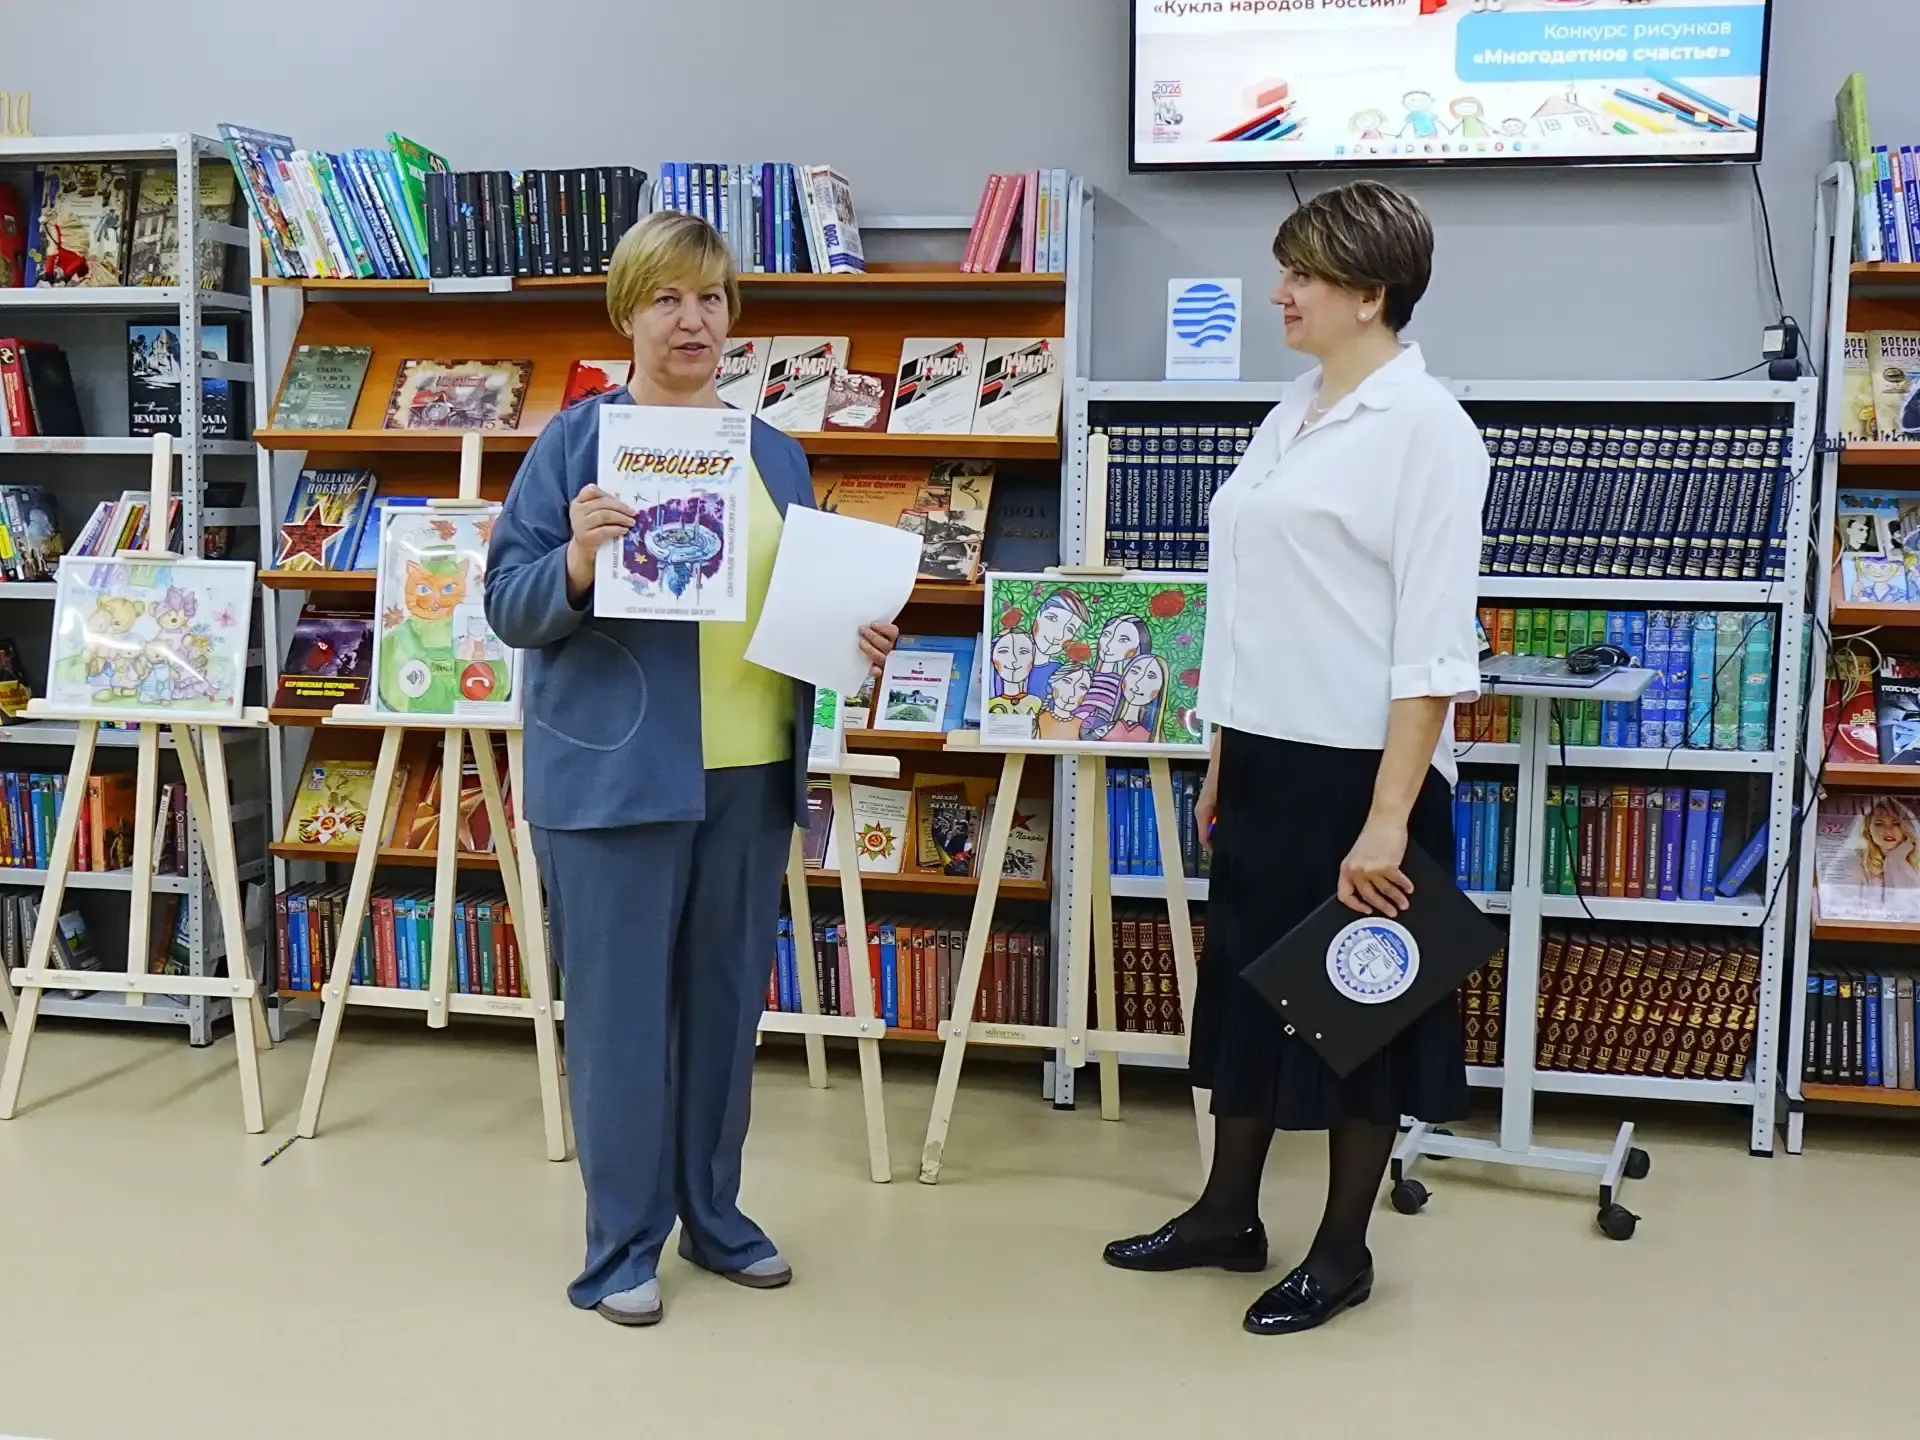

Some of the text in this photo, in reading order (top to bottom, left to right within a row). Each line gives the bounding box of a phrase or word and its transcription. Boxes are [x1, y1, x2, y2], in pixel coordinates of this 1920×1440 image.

[1230, 0, 1315, 16] народов
[1543, 21, 1733, 41] Конкурс рисунков
[1473, 44, 1731, 65] «Многодетное счастье»
[1153, 83, 1182, 95] 2026
[823, 223, 839, 248] 2000
[915, 353, 973, 377] ПАМЯТЬ
[1000, 351, 1057, 377] ПАМЯТЬ
[132, 414, 177, 424] ЗЕМЛЯ У
[617, 452, 735, 479] ПЕРВОЦВЕТ
[307, 483, 353, 494] ПОБЕДЫ
[1482, 546, 1492, 554] 26
[1499, 545, 1510, 553] 27
[1516, 545, 1528, 553] 27
[1532, 546, 1543, 554] 28
[1549, 546, 1560, 554] 28
[1567, 547, 1577, 555] 29
[1583, 547, 1594, 555] 29
[1602, 547, 1612, 555] 30
[1618, 547, 1629, 555] 30
[1654, 549, 1664, 557] 31
[1672, 548, 1684, 556] 32
[1691, 549, 1702, 557] 33
[1711, 549, 1721, 557] 34
[1730, 549, 1740, 558] 34
[1750, 549, 1759, 558] 35
